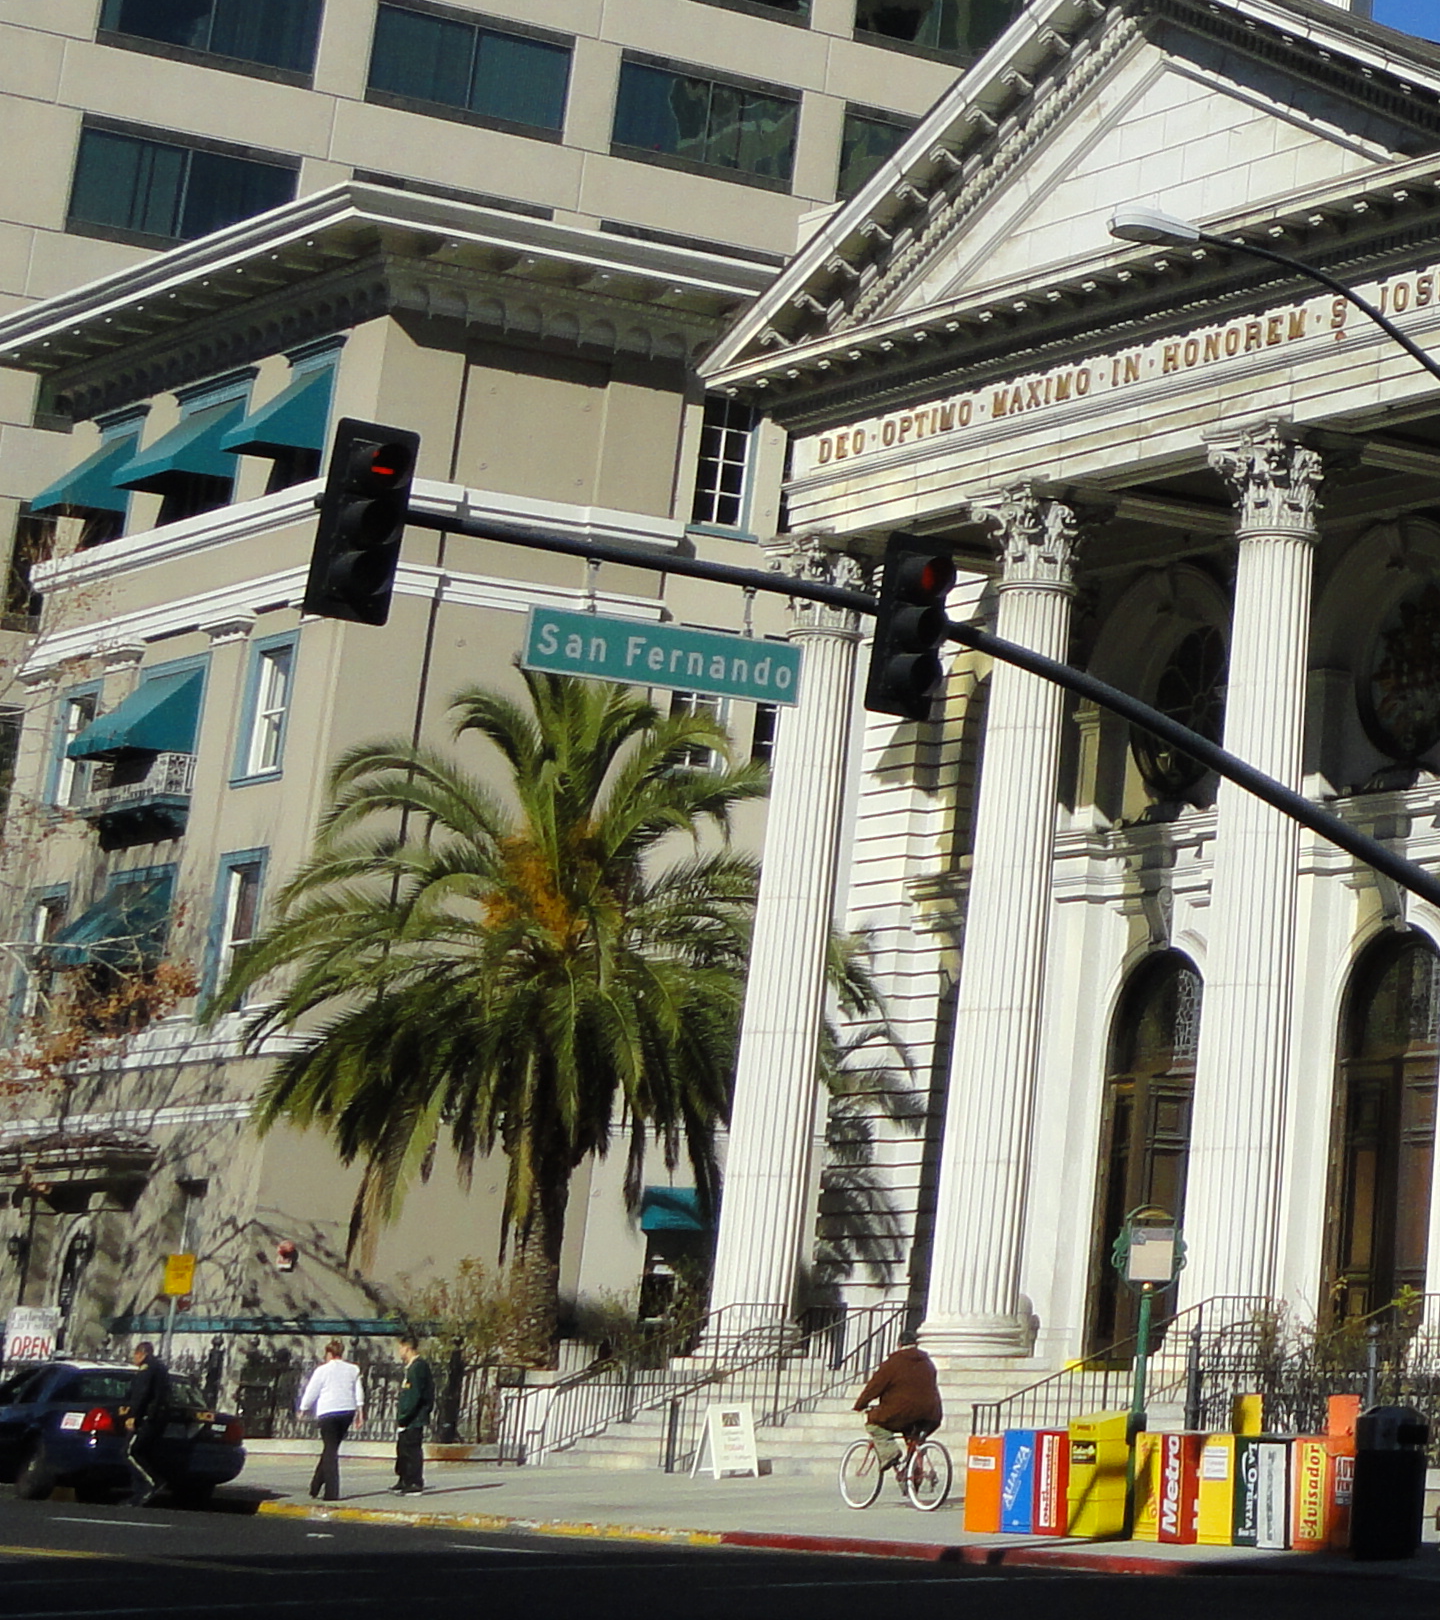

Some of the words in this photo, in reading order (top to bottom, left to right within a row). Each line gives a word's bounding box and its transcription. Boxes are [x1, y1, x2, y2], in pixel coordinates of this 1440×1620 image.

[818, 428, 866, 464] DEO
[882, 400, 973, 447] OPTIMO
[991, 367, 1092, 418] MAXIMO
[1111, 353, 1141, 387] IN
[1162, 308, 1307, 374] HONOREM
[537, 623, 607, 663] San
[626, 636, 792, 689] Fernando
[10, 1335, 52, 1359] OPEN
[1002, 1445, 1031, 1505] ALIANZA
[1162, 1435, 1180, 1534] Metro
[1303, 1445, 1320, 1538] Avisador
